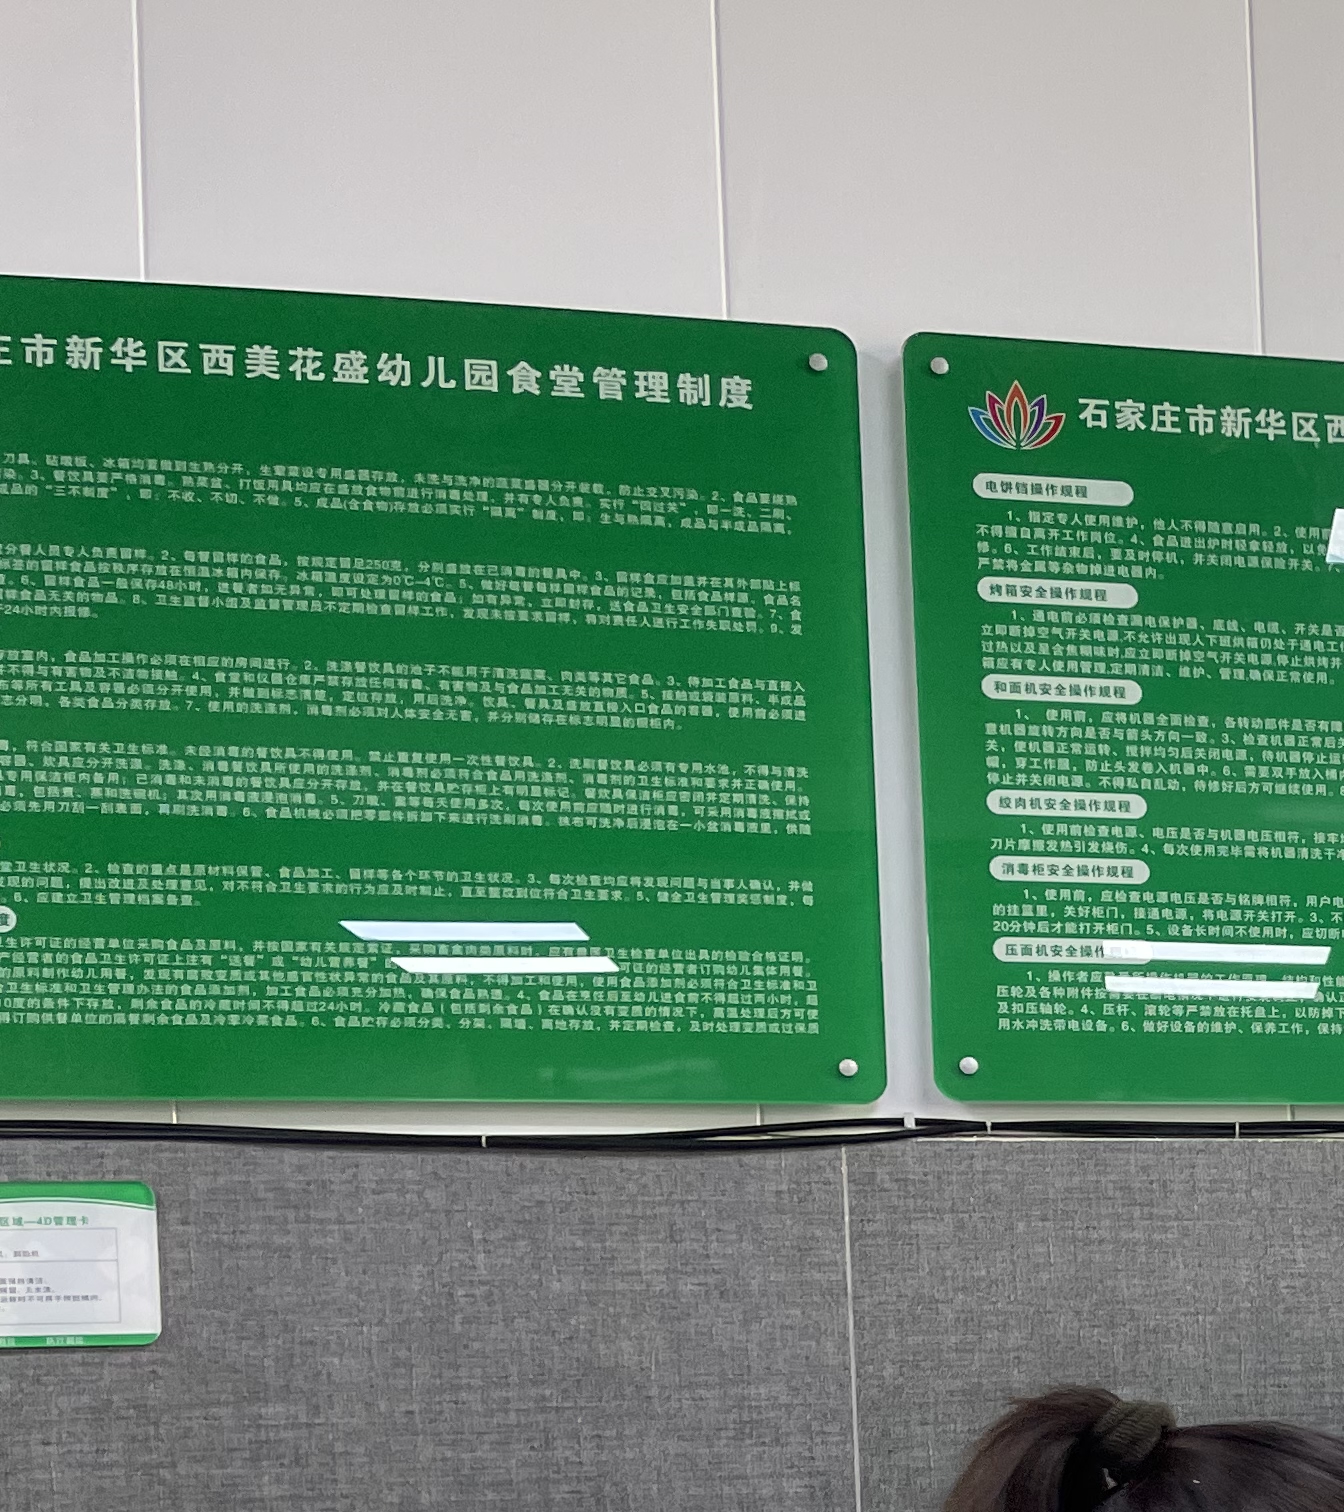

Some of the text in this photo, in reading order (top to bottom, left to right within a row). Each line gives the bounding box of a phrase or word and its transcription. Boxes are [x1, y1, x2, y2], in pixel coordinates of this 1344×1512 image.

[989, 583, 1107, 601] 烤箱安全操作规程
[994, 680, 1127, 698] 和面机安全操作规程
[998, 796, 1131, 813] 绞肉机安全操作规程
[1000, 862, 1134, 879] 消毒柜安全操作规程
[1004, 943, 1133, 959] 压面机安全操作
